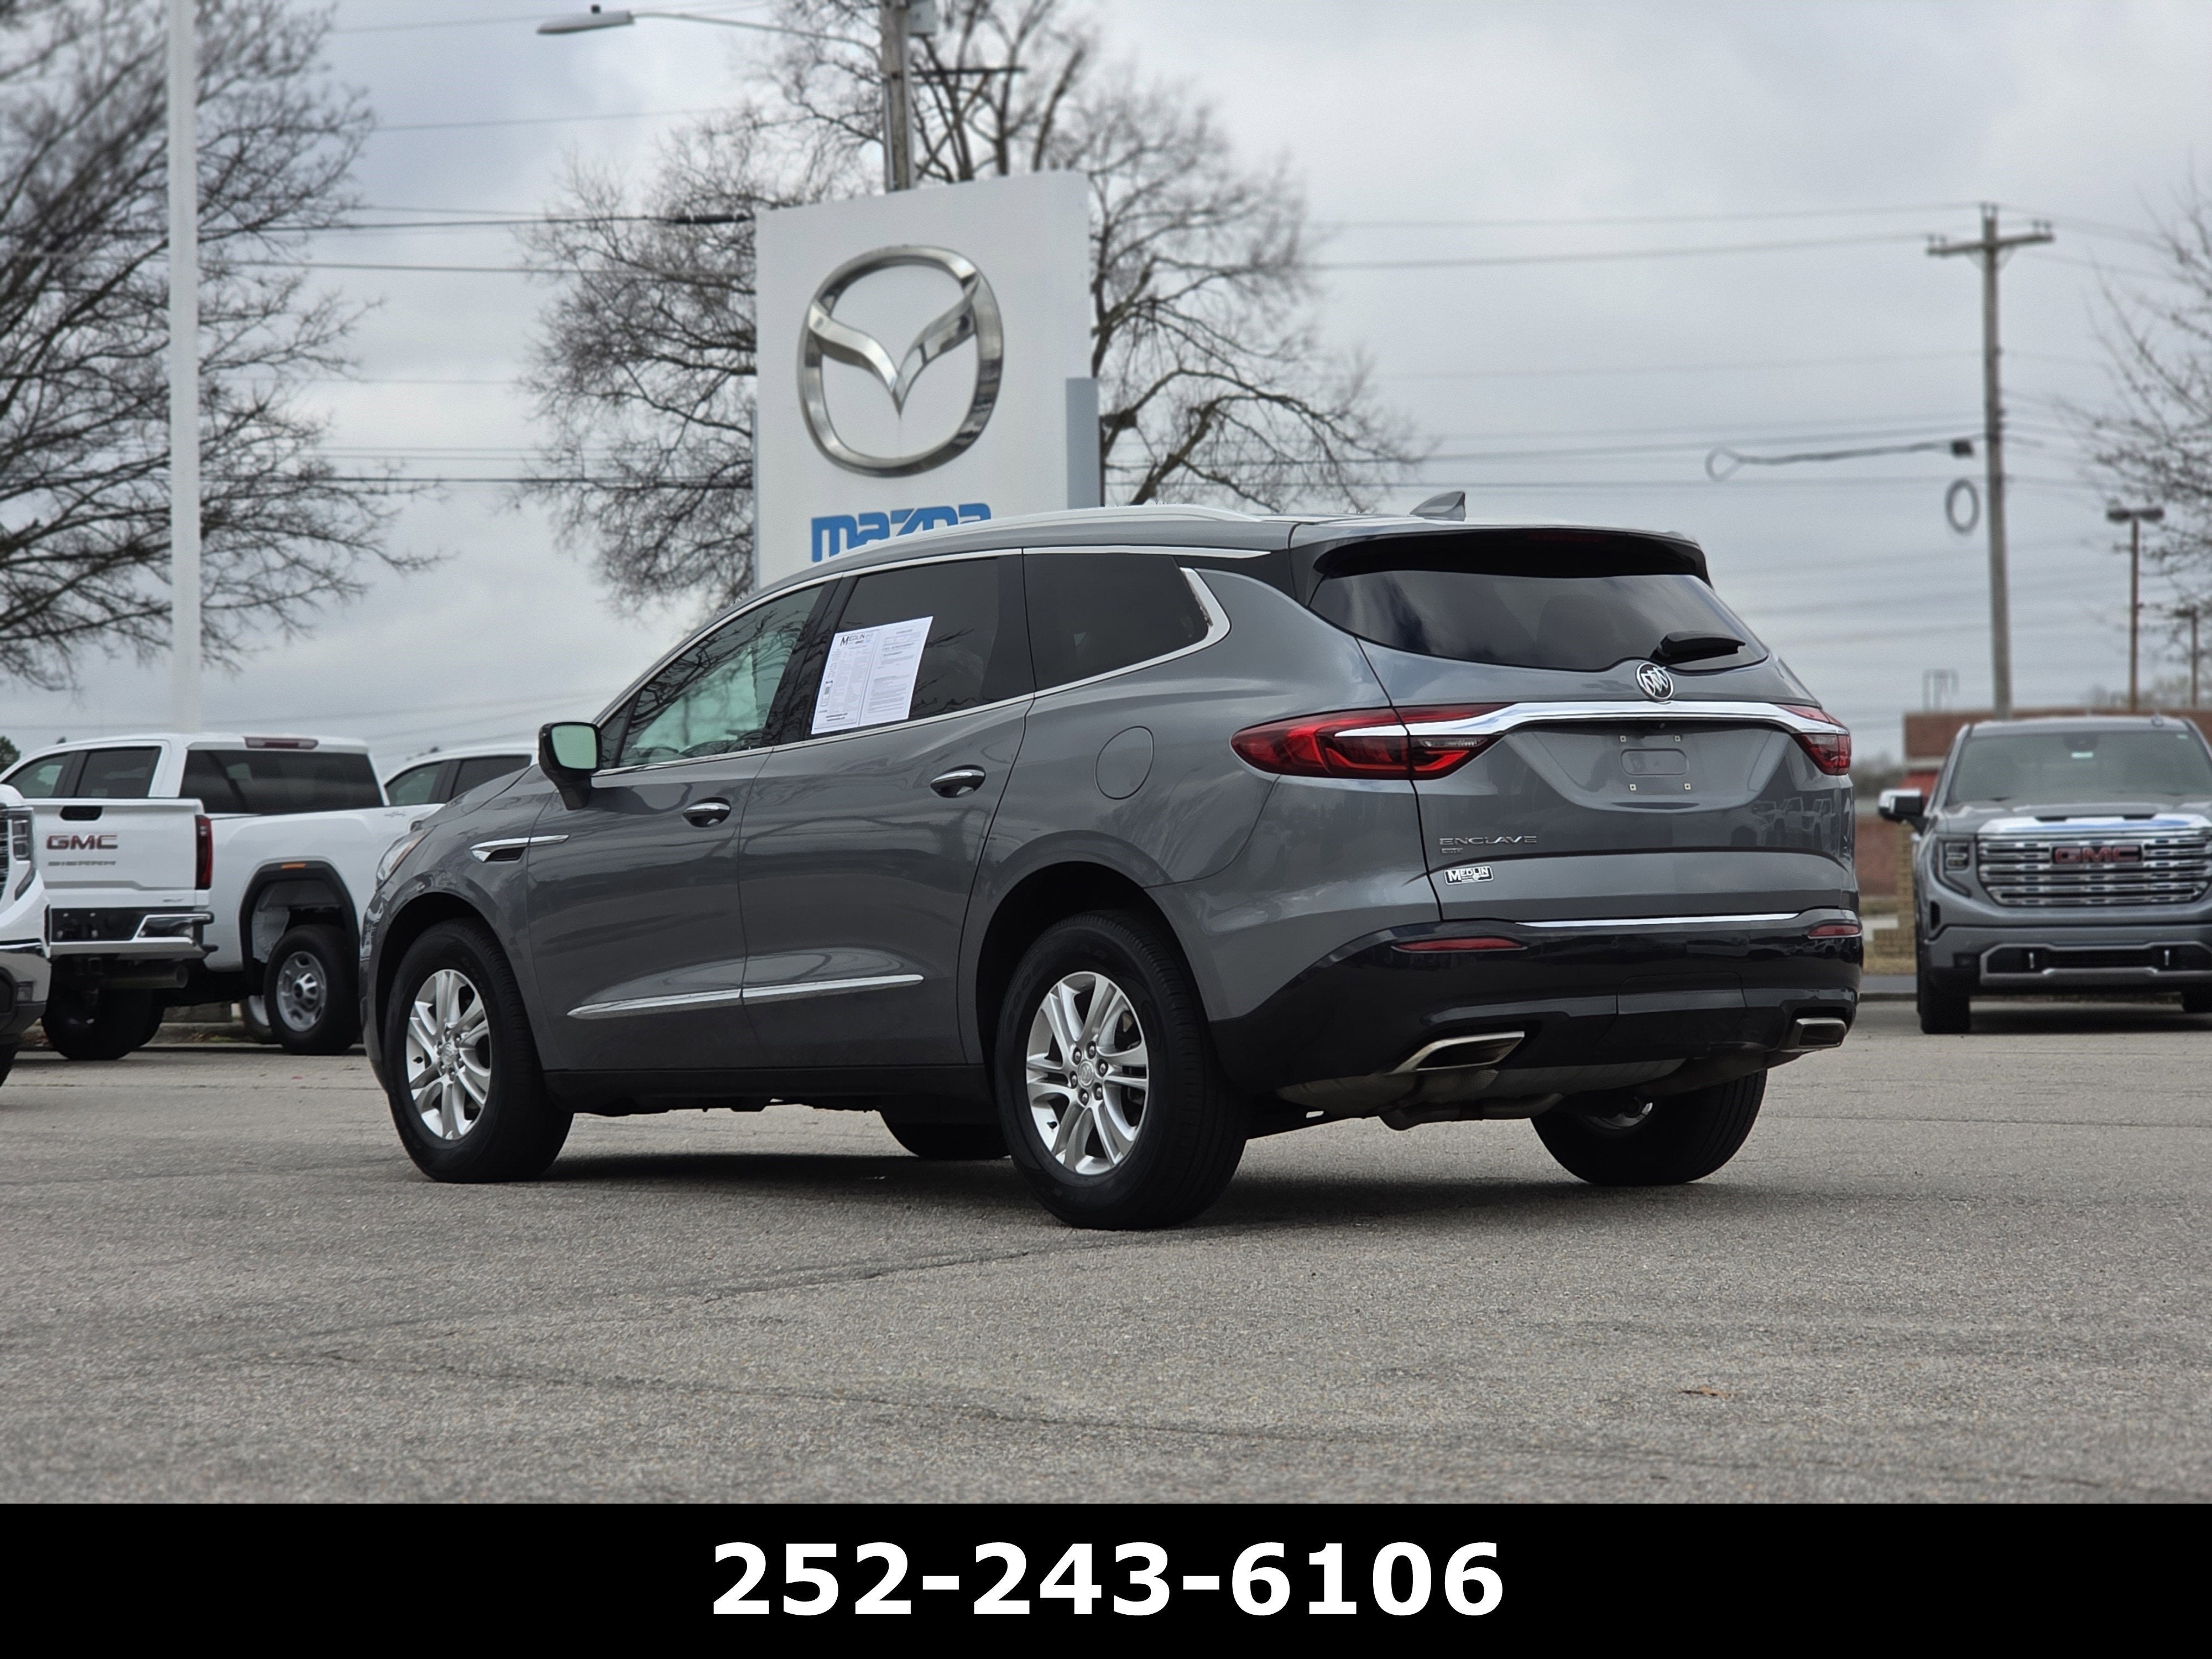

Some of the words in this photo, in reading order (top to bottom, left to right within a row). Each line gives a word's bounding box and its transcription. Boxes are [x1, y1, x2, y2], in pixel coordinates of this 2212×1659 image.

[46, 834, 118, 850] GMC
[1439, 836, 1537, 845] ENCLAVE
[2054, 846, 2139, 864] GMC
